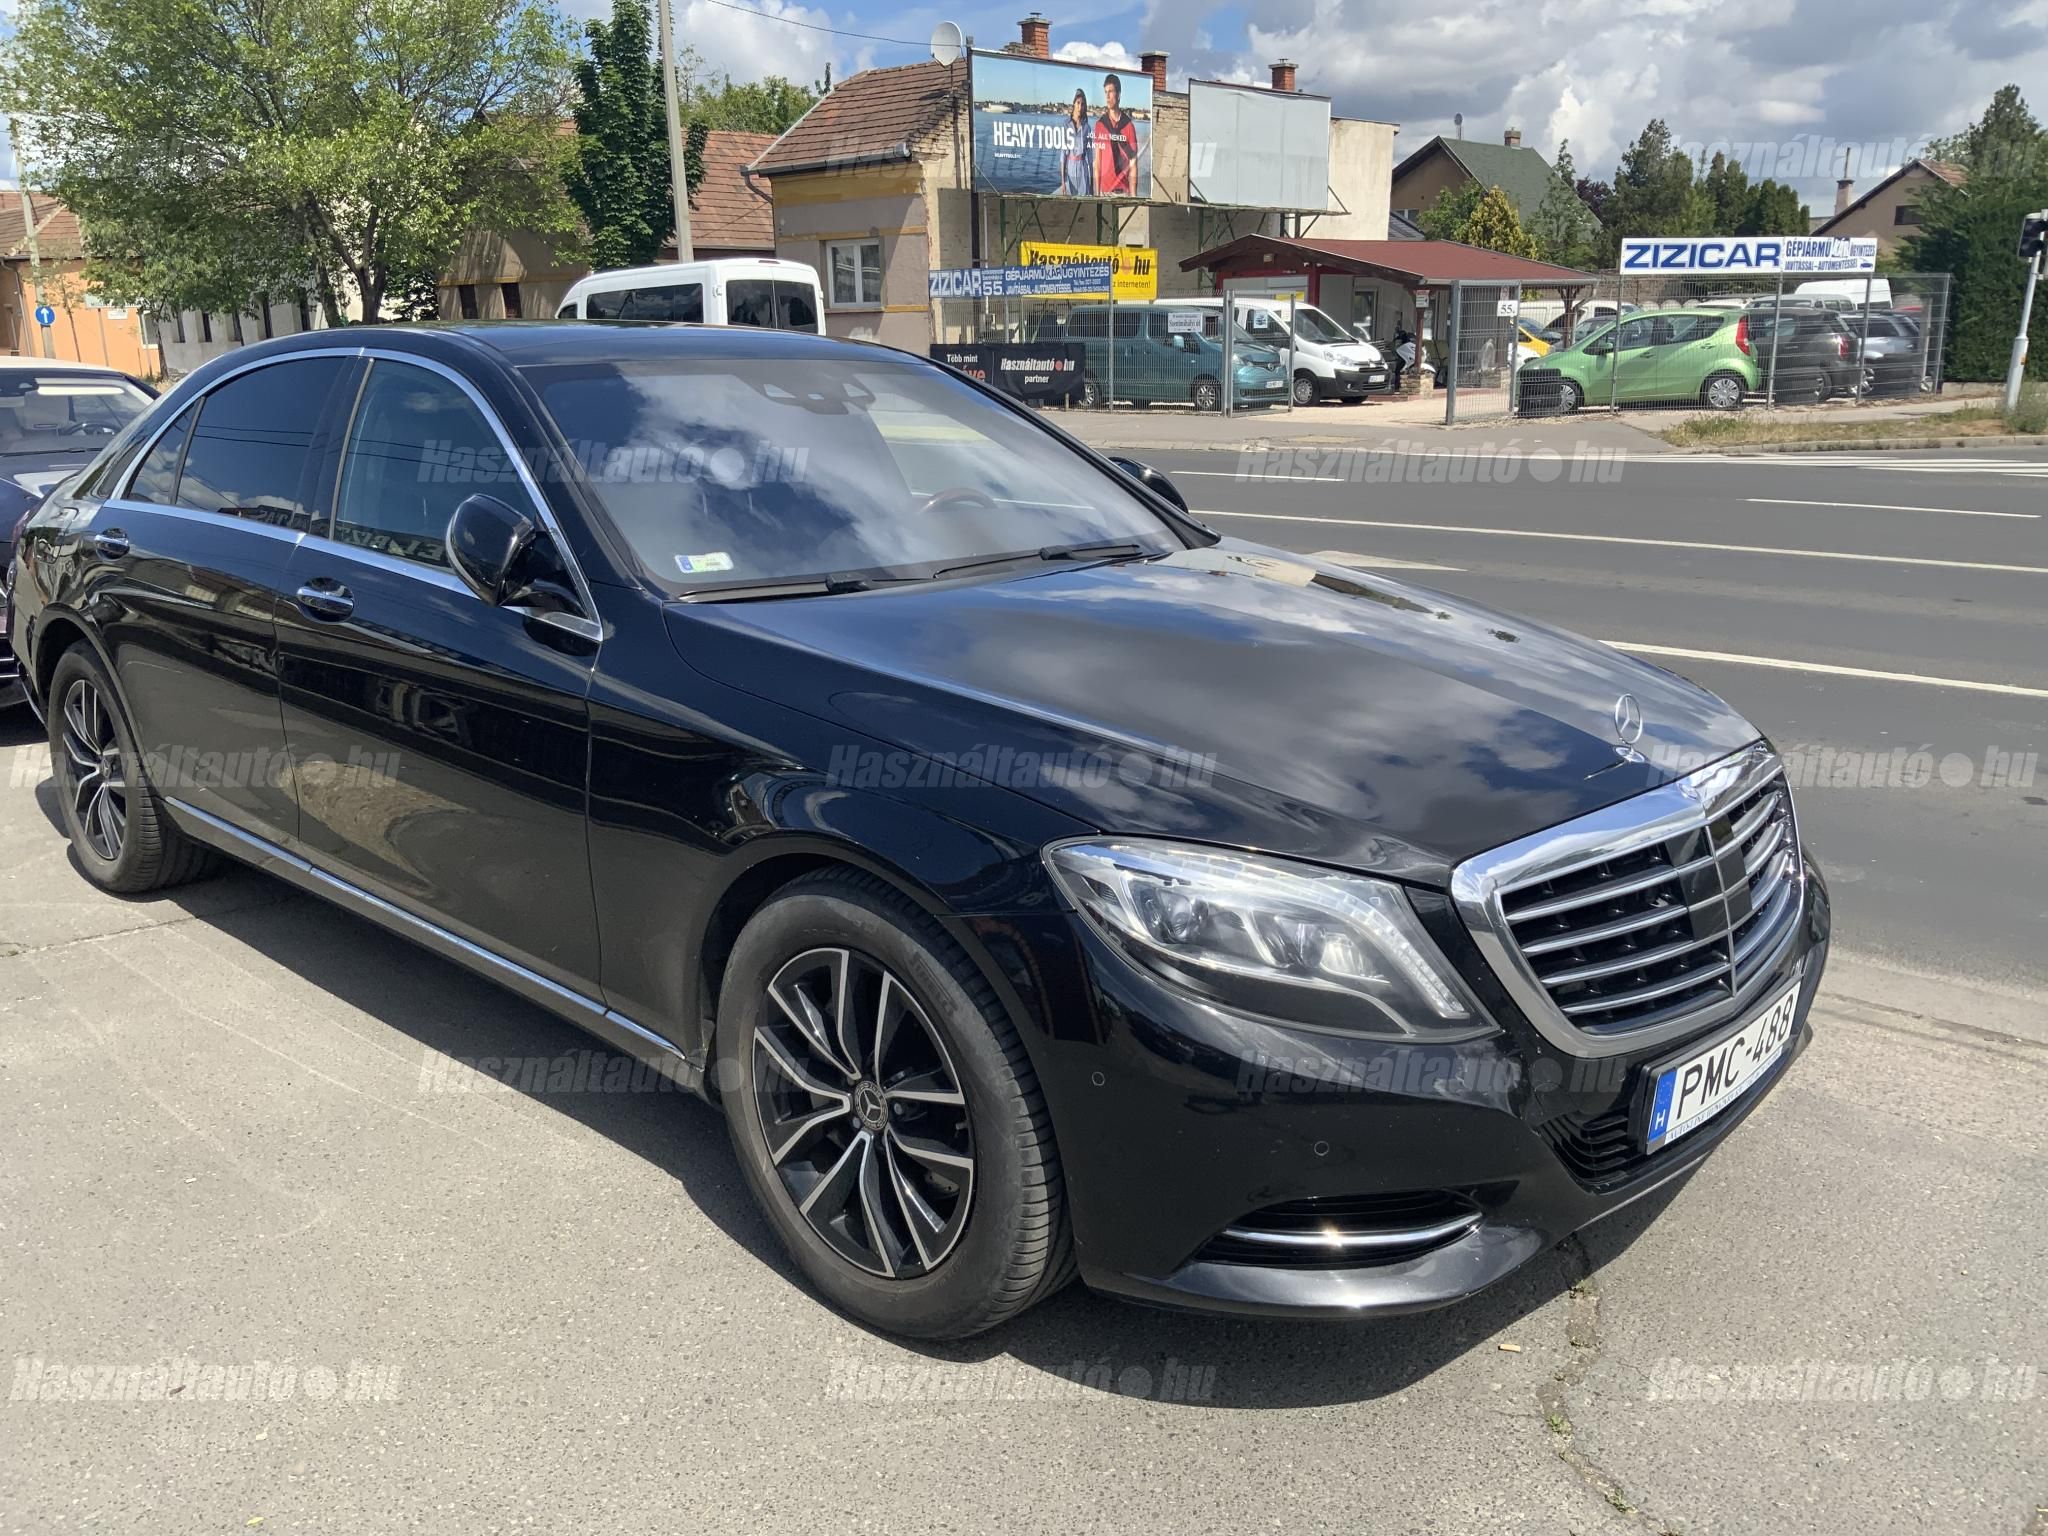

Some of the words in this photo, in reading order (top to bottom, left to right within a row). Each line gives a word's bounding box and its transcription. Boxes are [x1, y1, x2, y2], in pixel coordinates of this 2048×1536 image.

[1624, 243, 1781, 269] ZIZICAR
[929, 269, 982, 297] ZIZICAR
[946, 354, 962, 363] Több
[963, 354, 978, 363] mint
[1025, 375, 1049, 385] partner
[1676, 994, 1794, 1120] PMC-488
[1654, 1109, 1666, 1130] H
